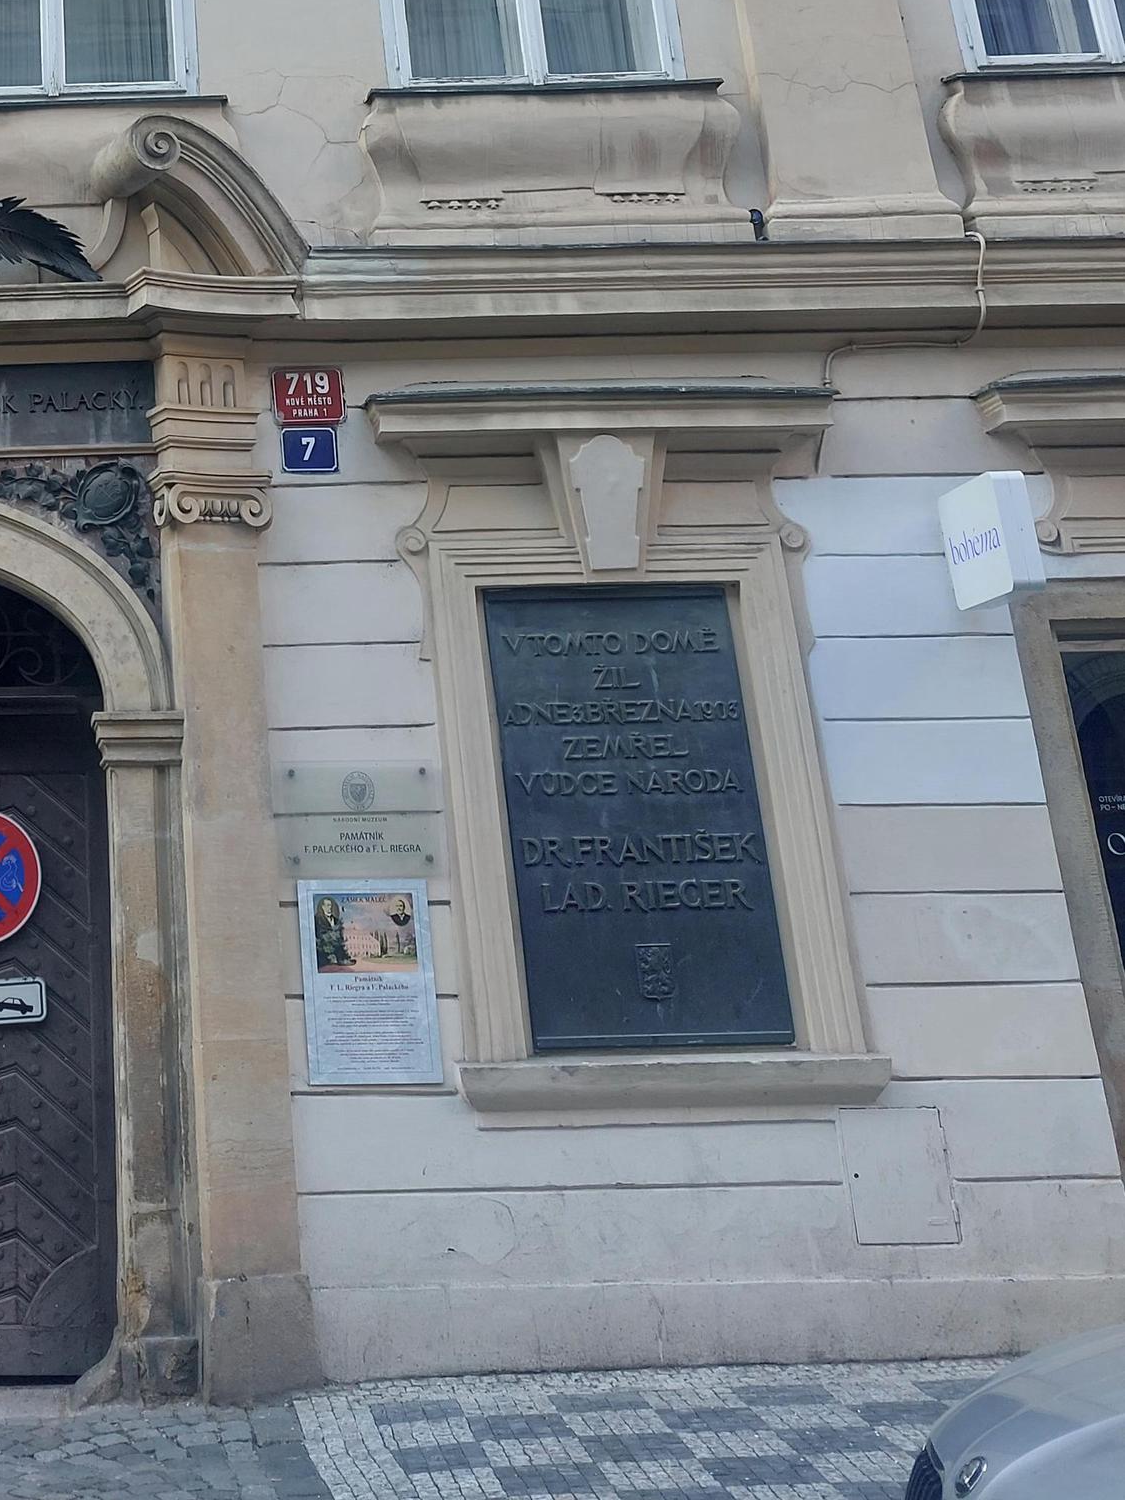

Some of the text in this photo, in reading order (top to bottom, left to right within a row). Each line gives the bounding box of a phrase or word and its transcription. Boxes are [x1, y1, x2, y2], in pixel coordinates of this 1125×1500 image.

[285, 372, 330, 395] 719
[285, 395, 332, 406] NOVÉ MĚSTO
[292, 408, 328, 418] PRAHA 1
[301, 437, 316, 461] 7
[632, 627, 720, 655] DOMĚ
[592, 664, 641, 690] ŽIL
[562, 731, 690, 761] ZEMŘEL
[339, 831, 385, 841] PAMÁTNÍK
[312, 843, 364, 854] PALACKÉHO
[372, 845, 380, 853] F.
[381, 845, 389, 853] L.
[390, 843, 422, 853] RIEGRA
[540, 881, 612, 913] LAD.
